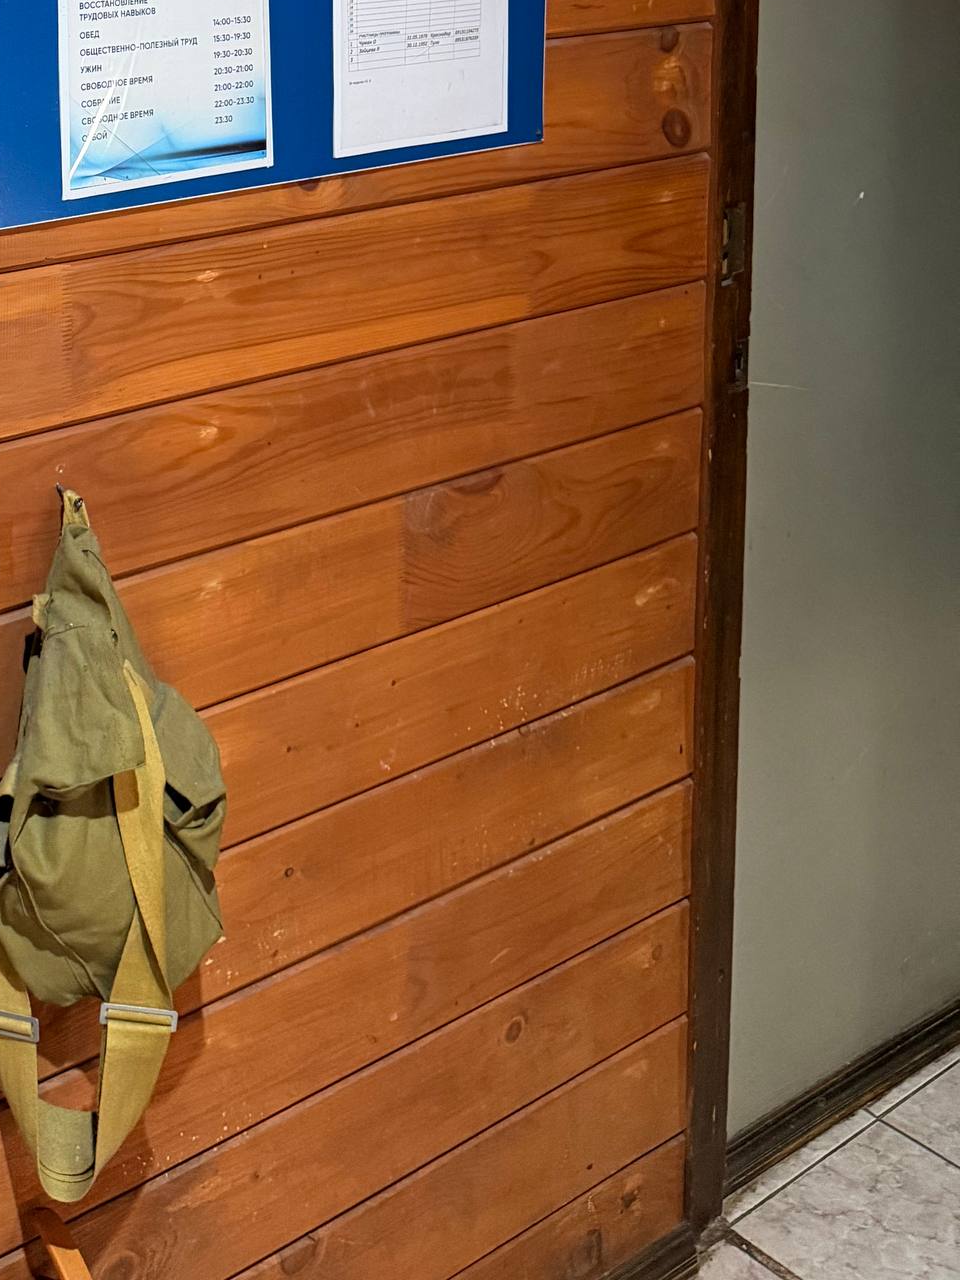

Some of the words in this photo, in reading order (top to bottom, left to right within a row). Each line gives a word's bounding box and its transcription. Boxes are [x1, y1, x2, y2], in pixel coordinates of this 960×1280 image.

[79, 10, 120, 22] ТРУДОВЫХ
[120, 7, 156, 17] НАВЫКОВ
[79, 30, 100, 40] ОБЕД
[213, 16, 252, 26] 14:00-15:30
[79, 38, 179, 57] ОБЩЕСТВЕННО-ПОЛЕЗНЫЙ
[180, 37, 198, 47] ТРУД
[213, 32, 251, 43] 15:30-19:30
[80, 64, 102, 74] УЖИН
[213, 48, 253, 59] 19:30-20:30
[129, 75, 153, 86] ВРЕМЯ
[213, 64, 254, 75] 20:30-21:00
[81, 96, 120, 108] СОБРИЕ
[214, 80, 254, 92] 21:00-22:00
[130, 108, 154, 119] ВРЕМЯ
[214, 96, 255, 108] 22:00-23:30
[214, 115, 233, 125] 23:30
